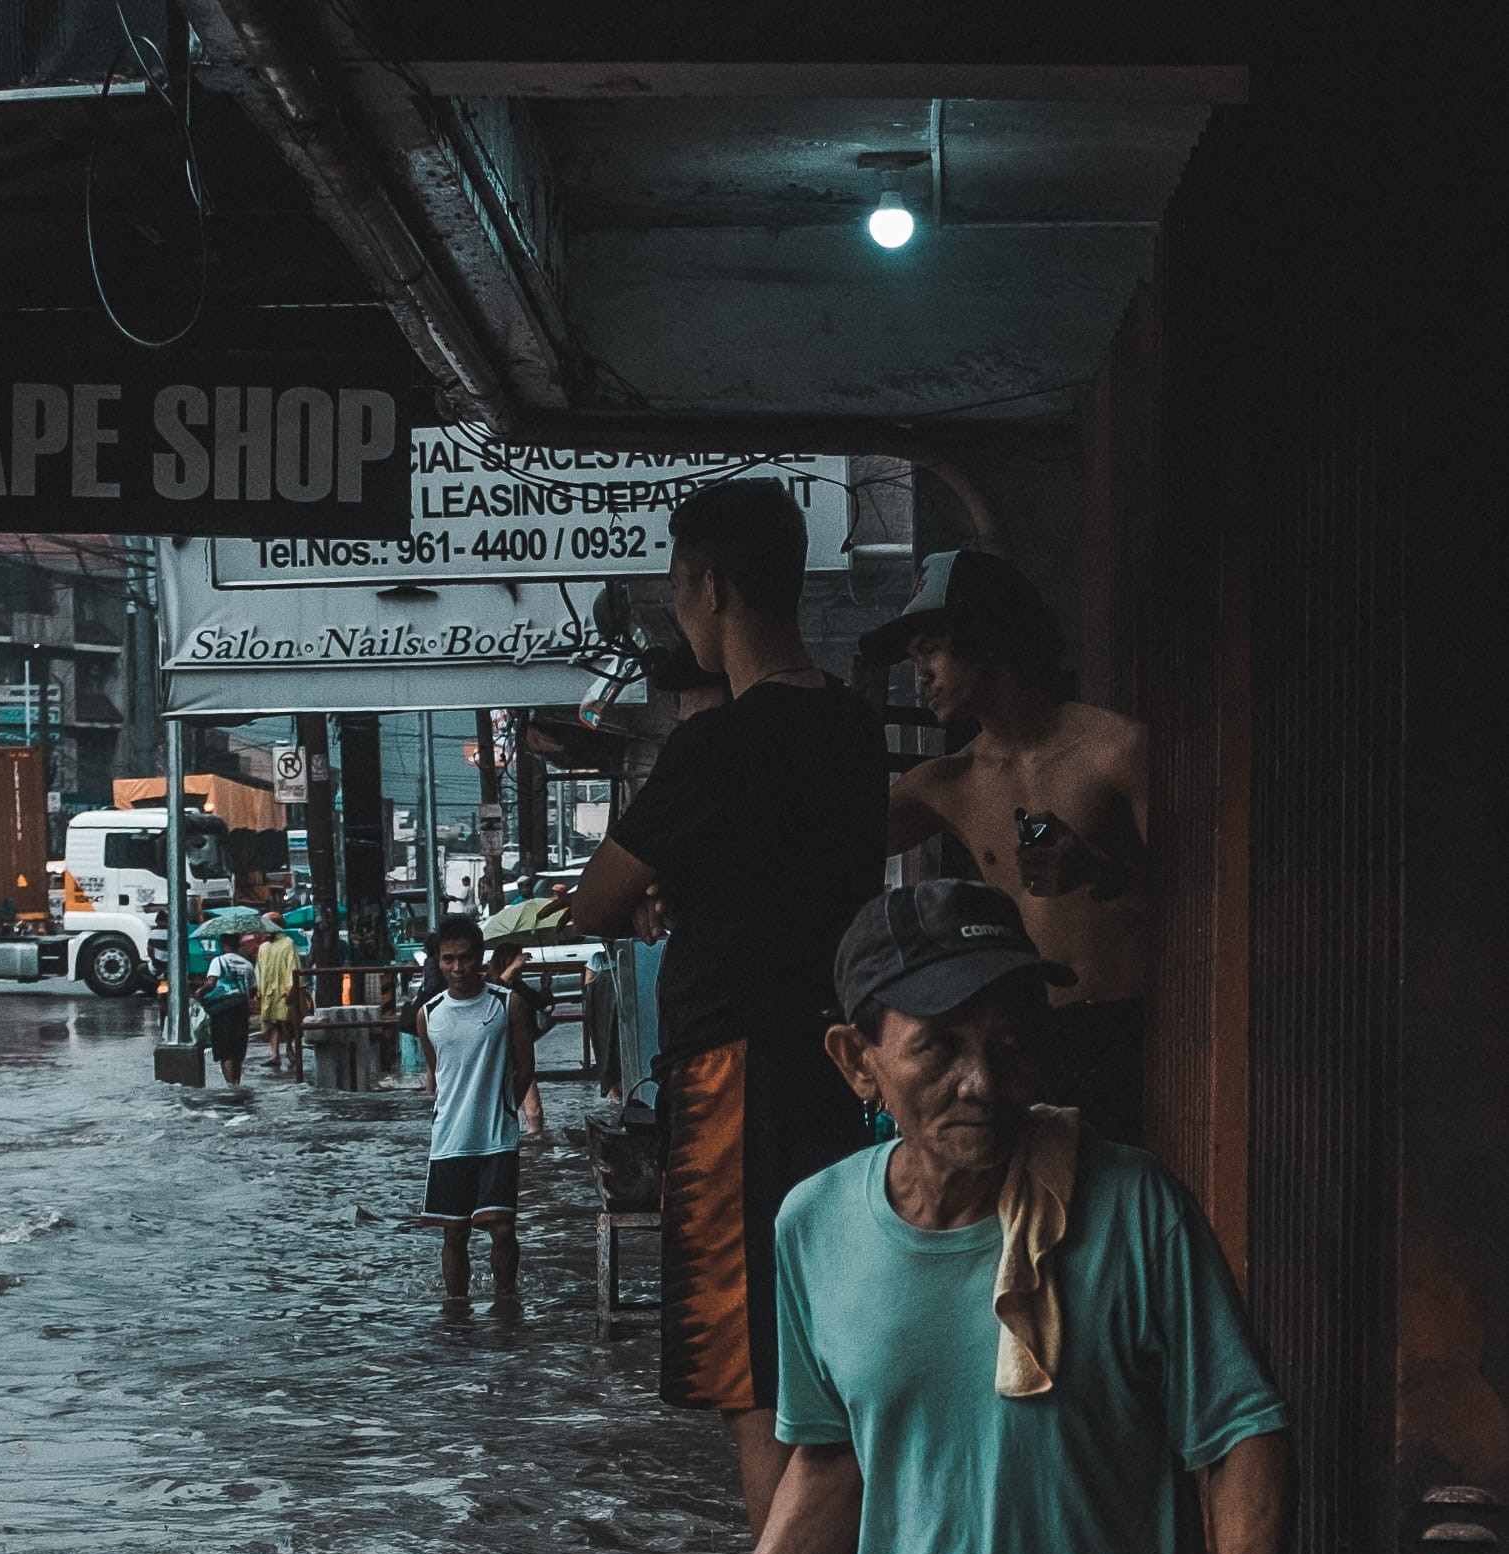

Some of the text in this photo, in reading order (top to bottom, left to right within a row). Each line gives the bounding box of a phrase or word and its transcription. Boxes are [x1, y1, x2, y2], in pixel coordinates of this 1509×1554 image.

[152, 384, 396, 502] SHOP
[411, 440, 475, 475] IAL
[480, 442, 620, 473] SPACES
[422, 484, 573, 518] LEASING
[192, 629, 295, 660] Salon
[321, 626, 422, 658] Nails
[442, 623, 544, 665] Body
